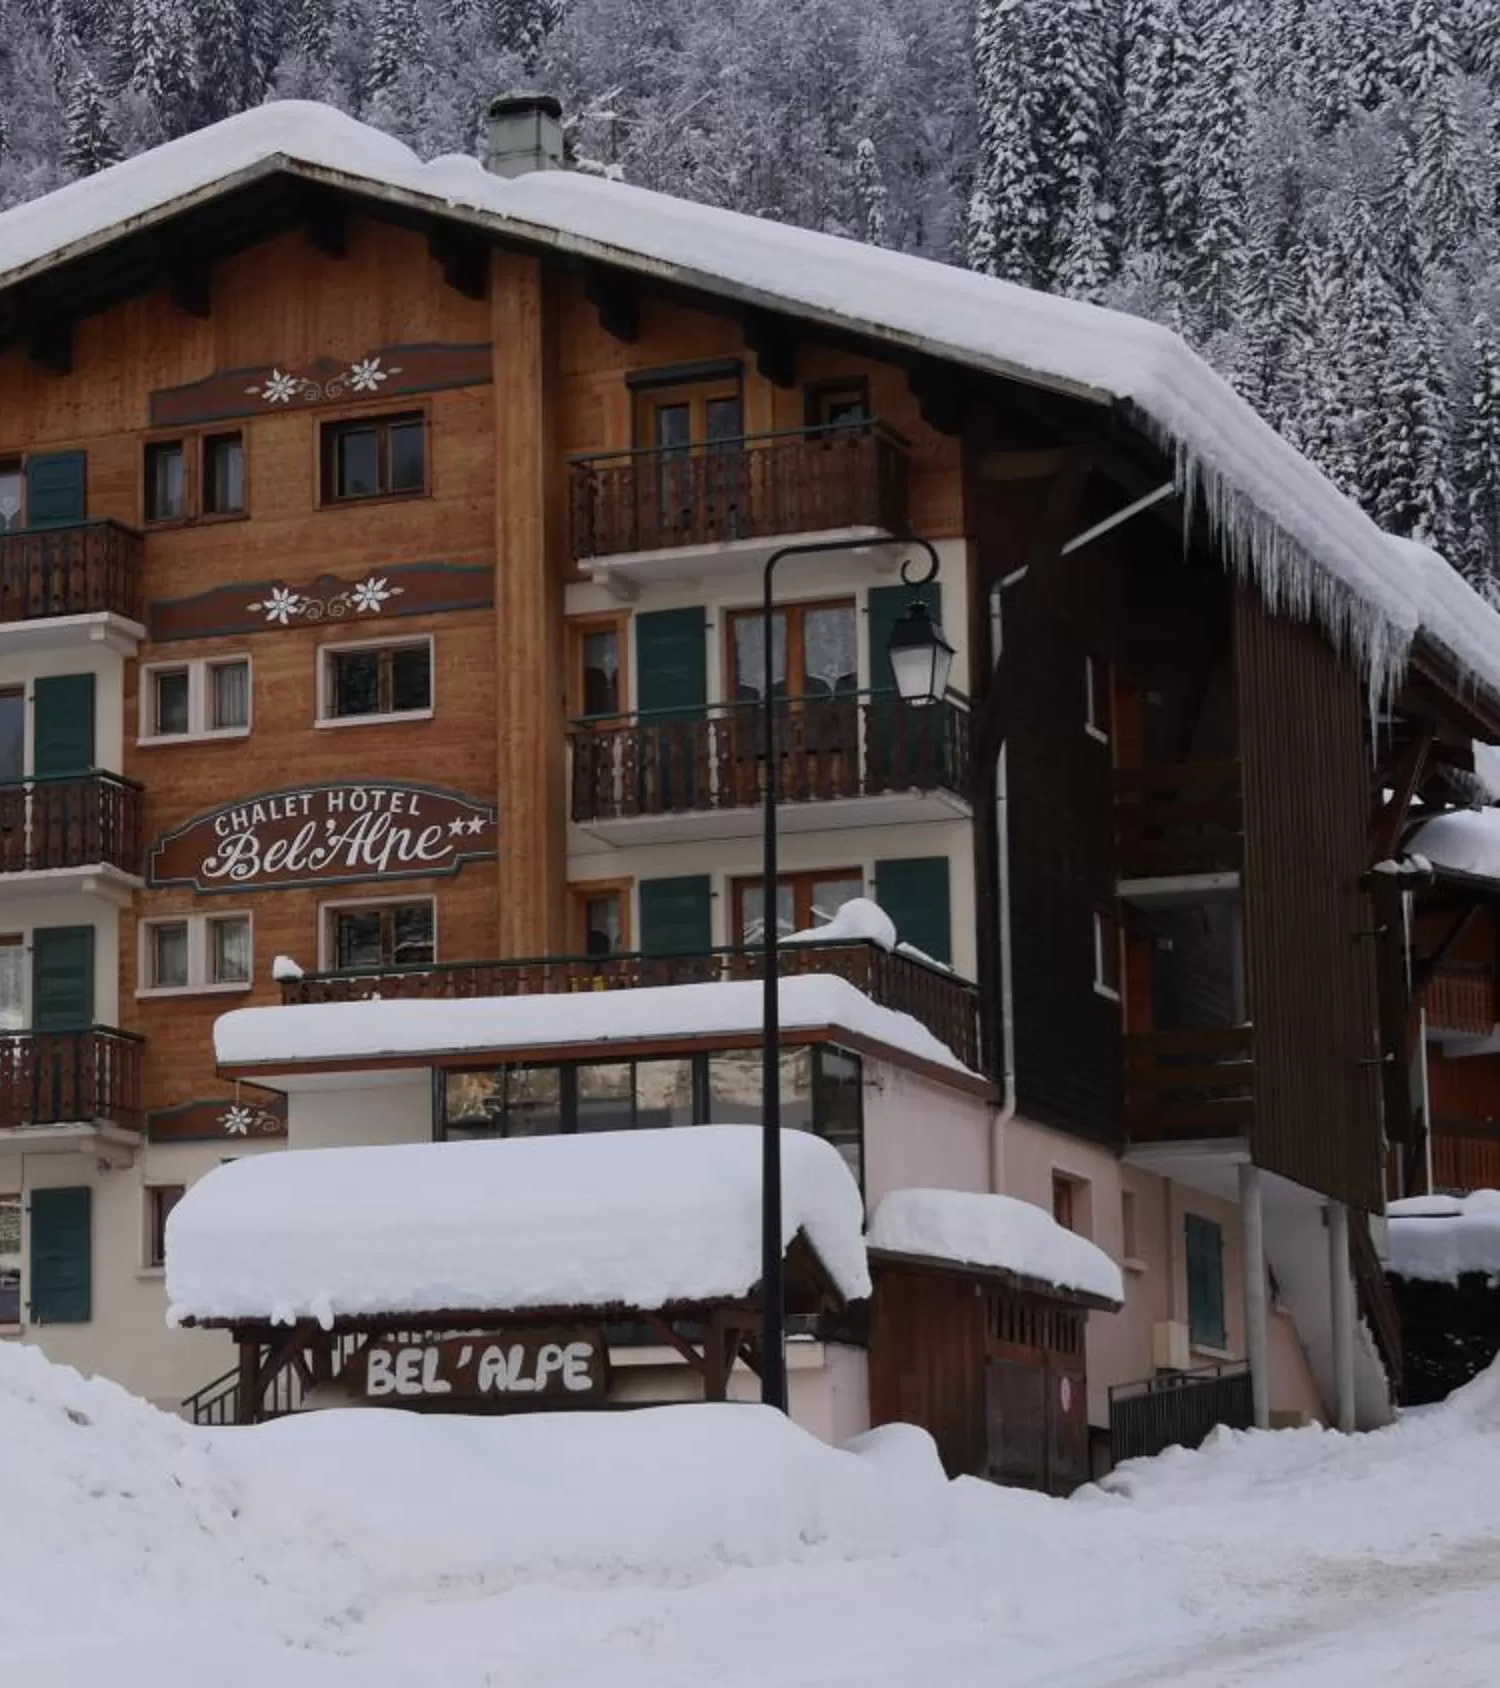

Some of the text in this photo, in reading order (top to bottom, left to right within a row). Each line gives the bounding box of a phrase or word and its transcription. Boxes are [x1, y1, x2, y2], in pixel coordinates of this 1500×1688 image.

[214, 787, 421, 836] CHALET HÔTEL
[201, 811, 454, 881] Bel'Alpe
